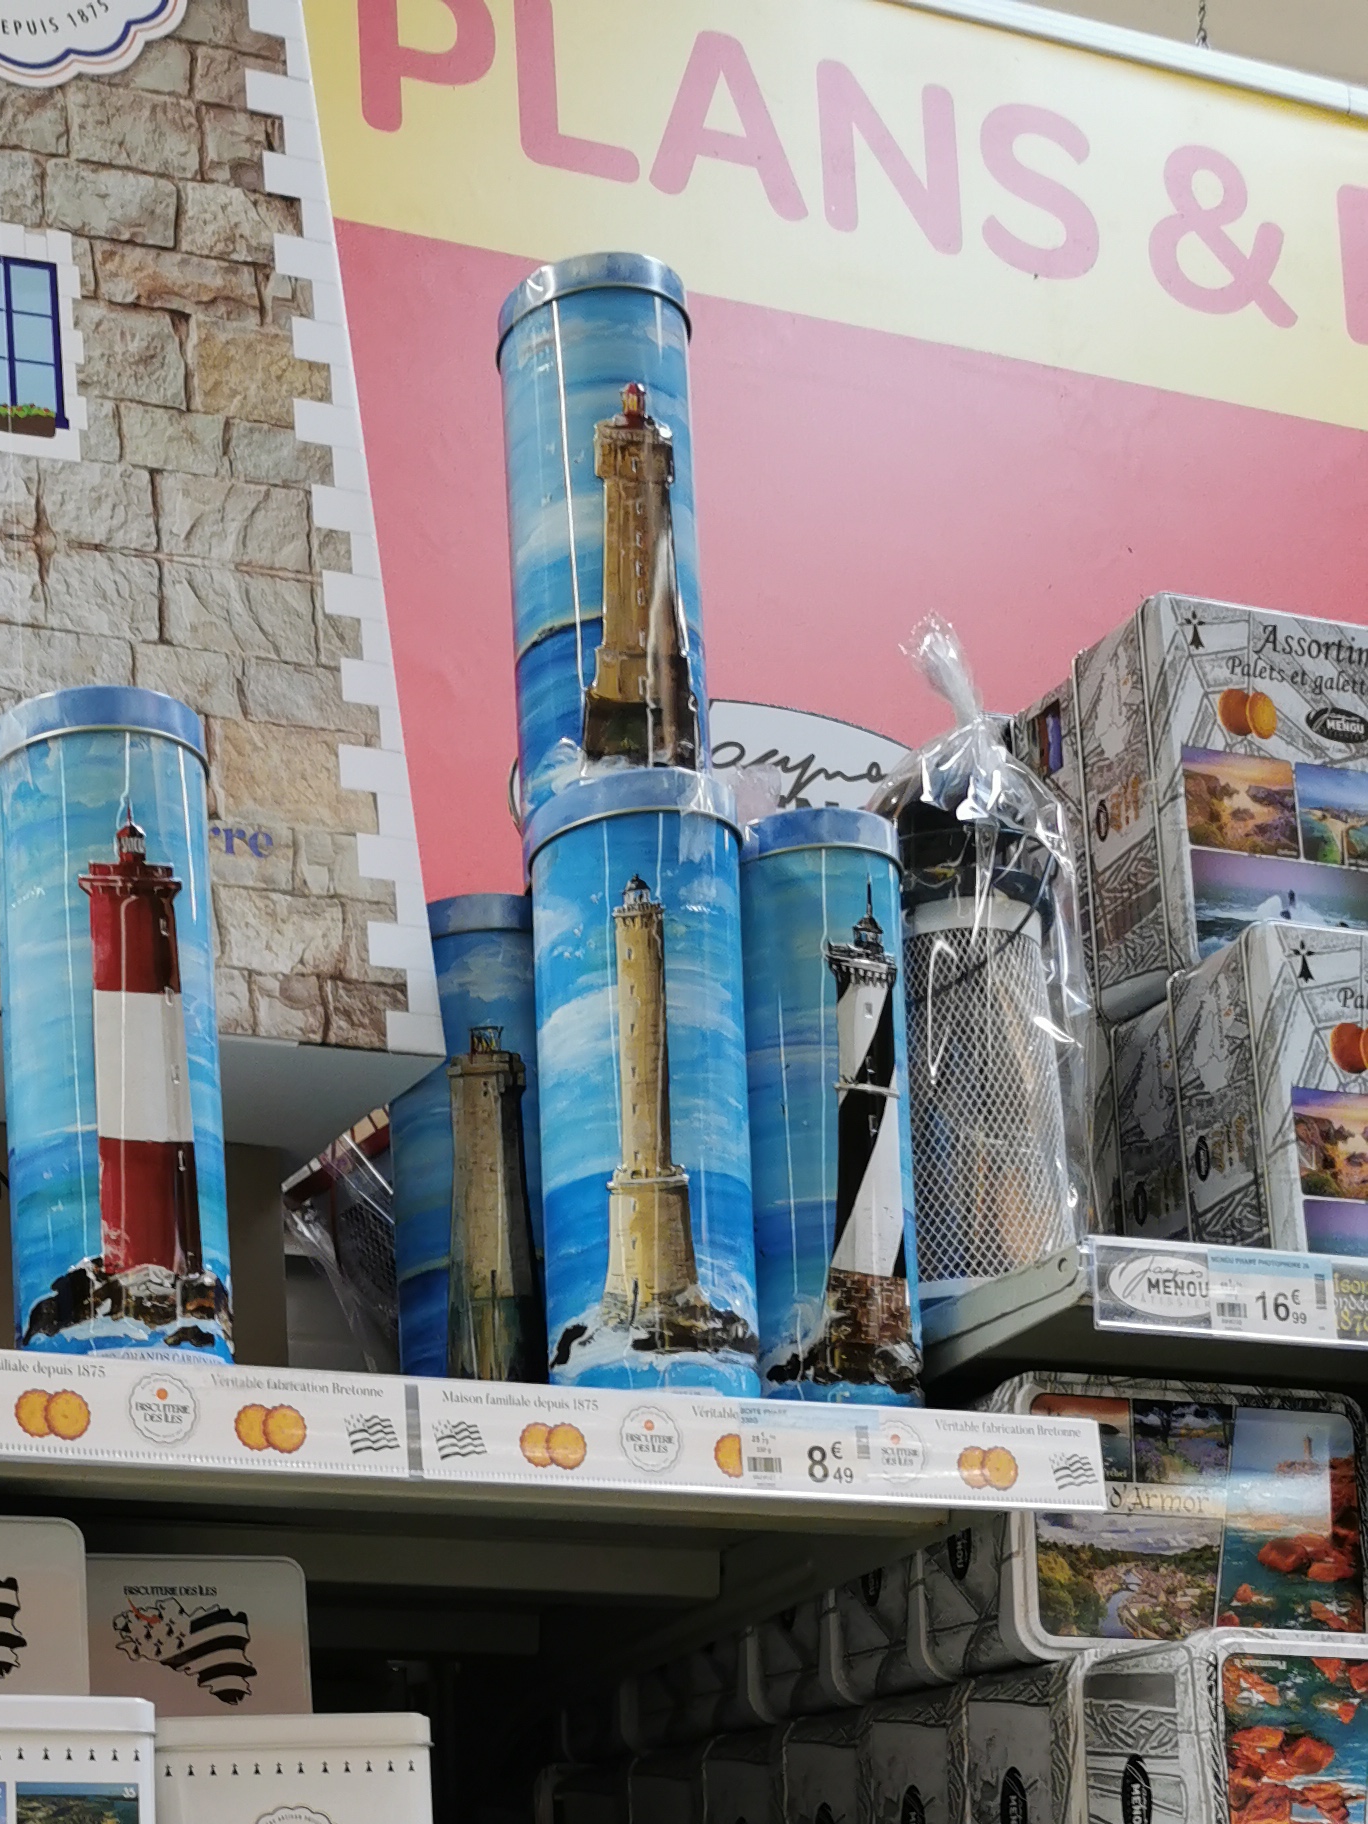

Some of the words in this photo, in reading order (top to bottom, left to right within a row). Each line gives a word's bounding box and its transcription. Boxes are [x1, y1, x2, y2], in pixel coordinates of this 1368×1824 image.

[66, 0, 109, 28] 1875
[357, 0, 1100, 280] PLANS
[1147, 145, 1298, 329] &
[1226, 656, 1285, 682] Palets
[1290, 668, 1308, 683] et
[1147, 1277, 1209, 1298] MENOU
[1291, 1290, 1301, 1305] €
[1256, 1291, 1290, 1321] 16
[1292, 1312, 1307, 1325] 99
[831, 1441, 843, 1459] €
[807, 1445, 829, 1483] 8
[833, 1467, 854, 1483] 49
